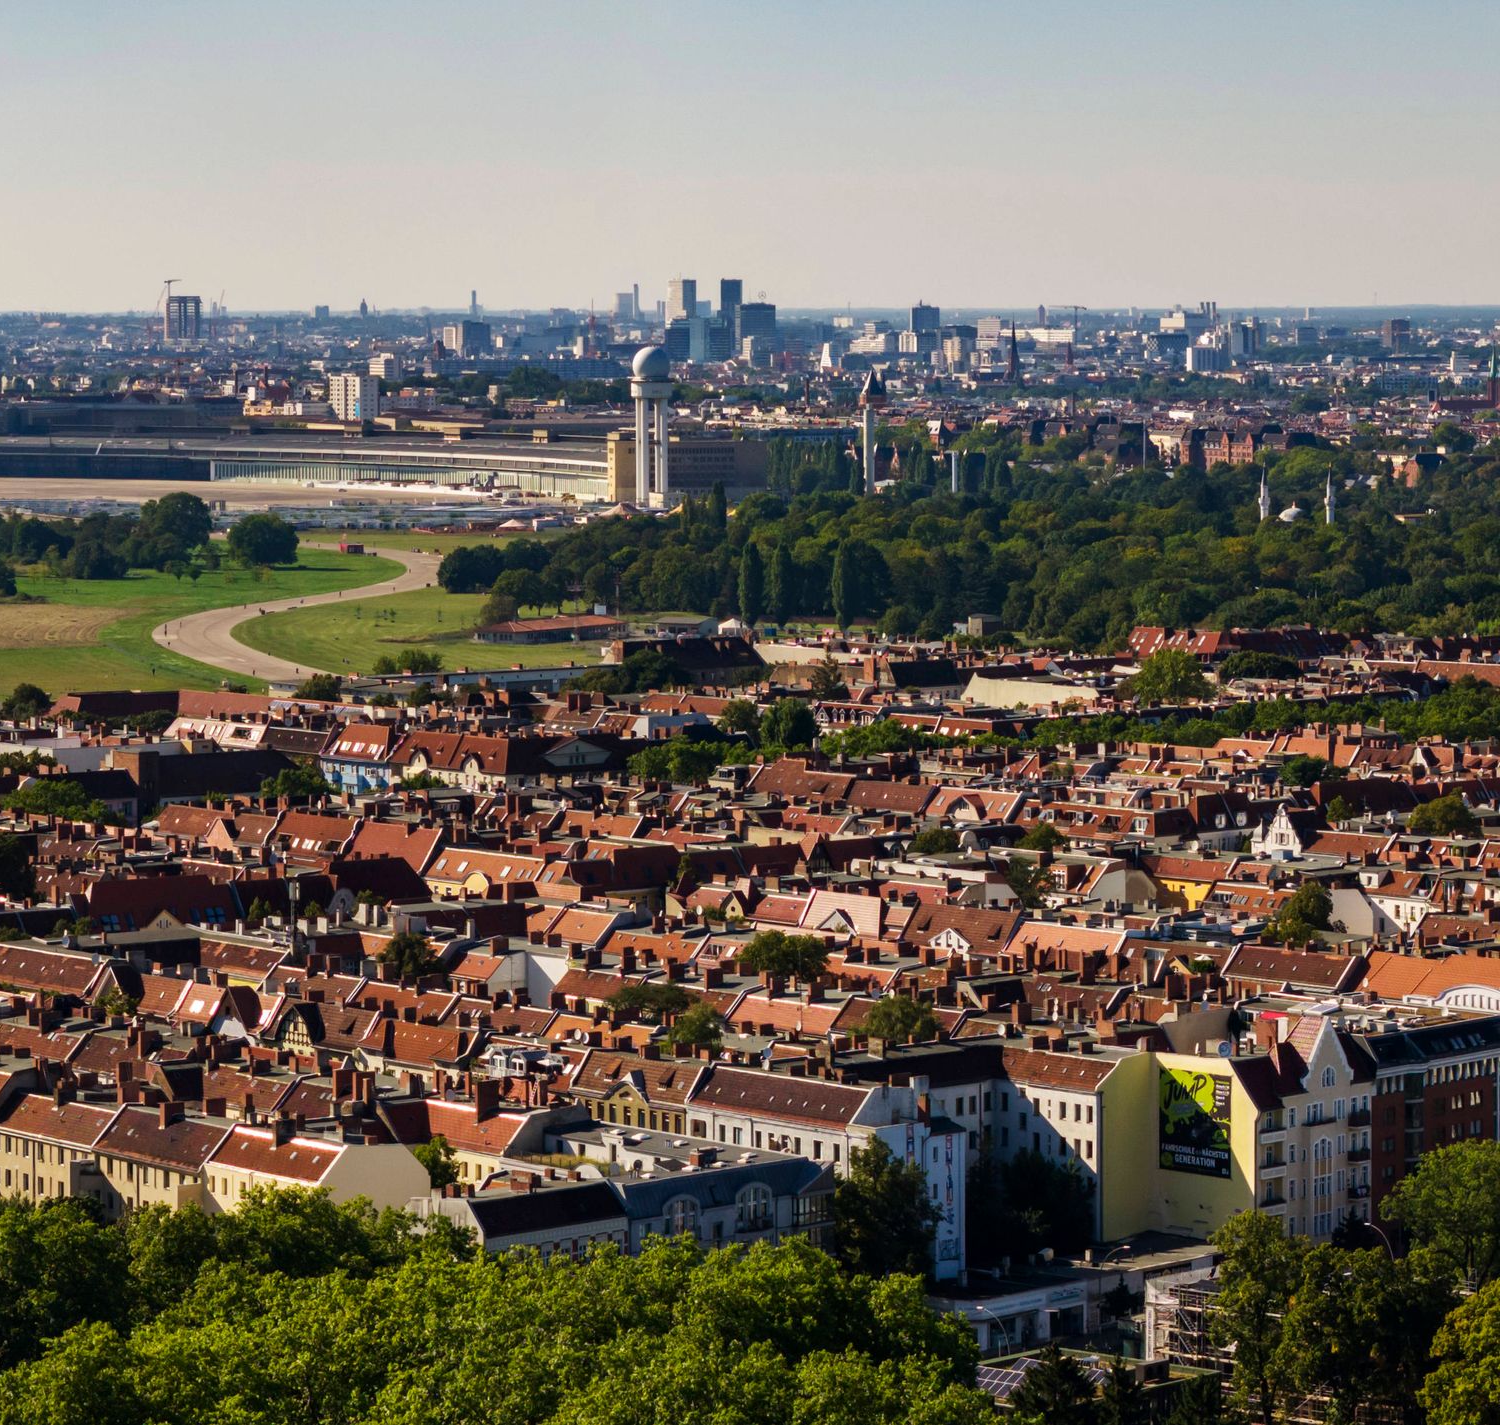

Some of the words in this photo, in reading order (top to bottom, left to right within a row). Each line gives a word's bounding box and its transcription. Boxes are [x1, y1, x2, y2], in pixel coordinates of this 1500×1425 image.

[1164, 1074, 1207, 1109] JUMP
[1161, 1143, 1195, 1155] FAHRSCHULE
[1202, 1147, 1228, 1160] NÄCHSTEN
[1175, 1154, 1215, 1168] GENERATION
